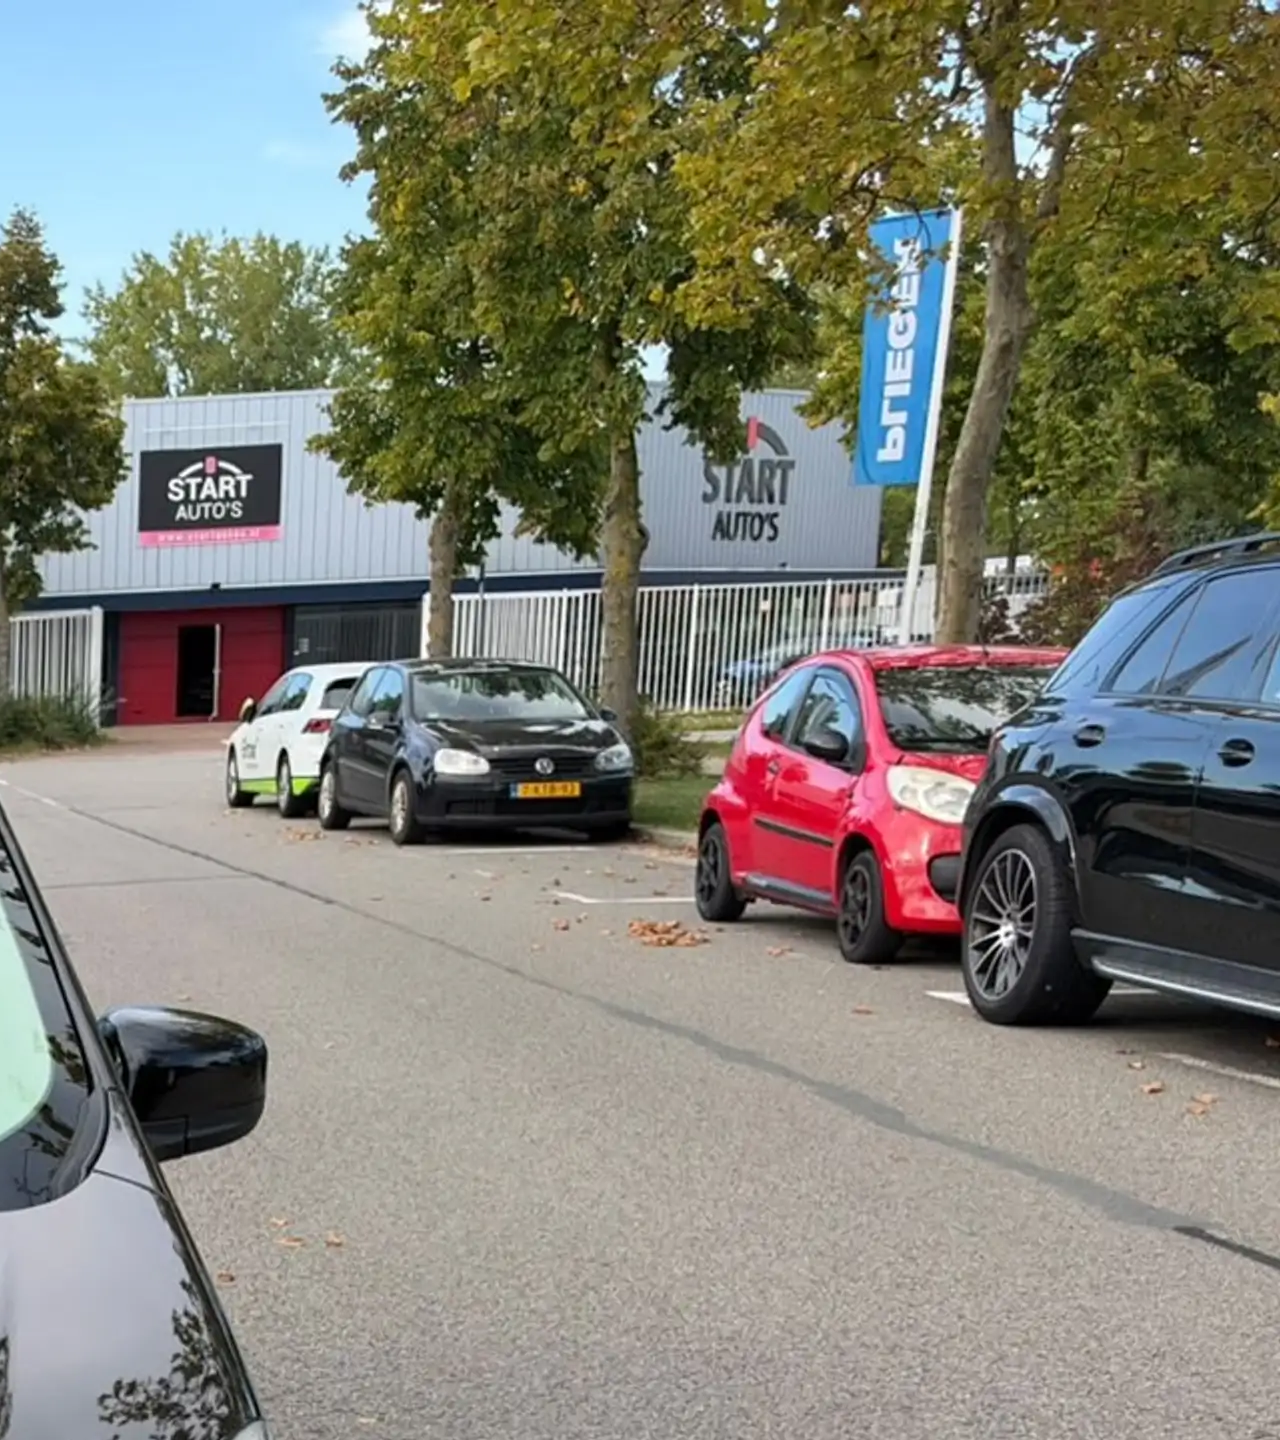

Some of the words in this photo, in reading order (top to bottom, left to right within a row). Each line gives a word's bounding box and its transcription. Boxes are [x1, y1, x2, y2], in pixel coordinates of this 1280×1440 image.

[167, 473, 254, 502] START
[702, 458, 795, 505] START
[174, 500, 244, 521] AUTO'S
[711, 510, 780, 542] AUTO'S
